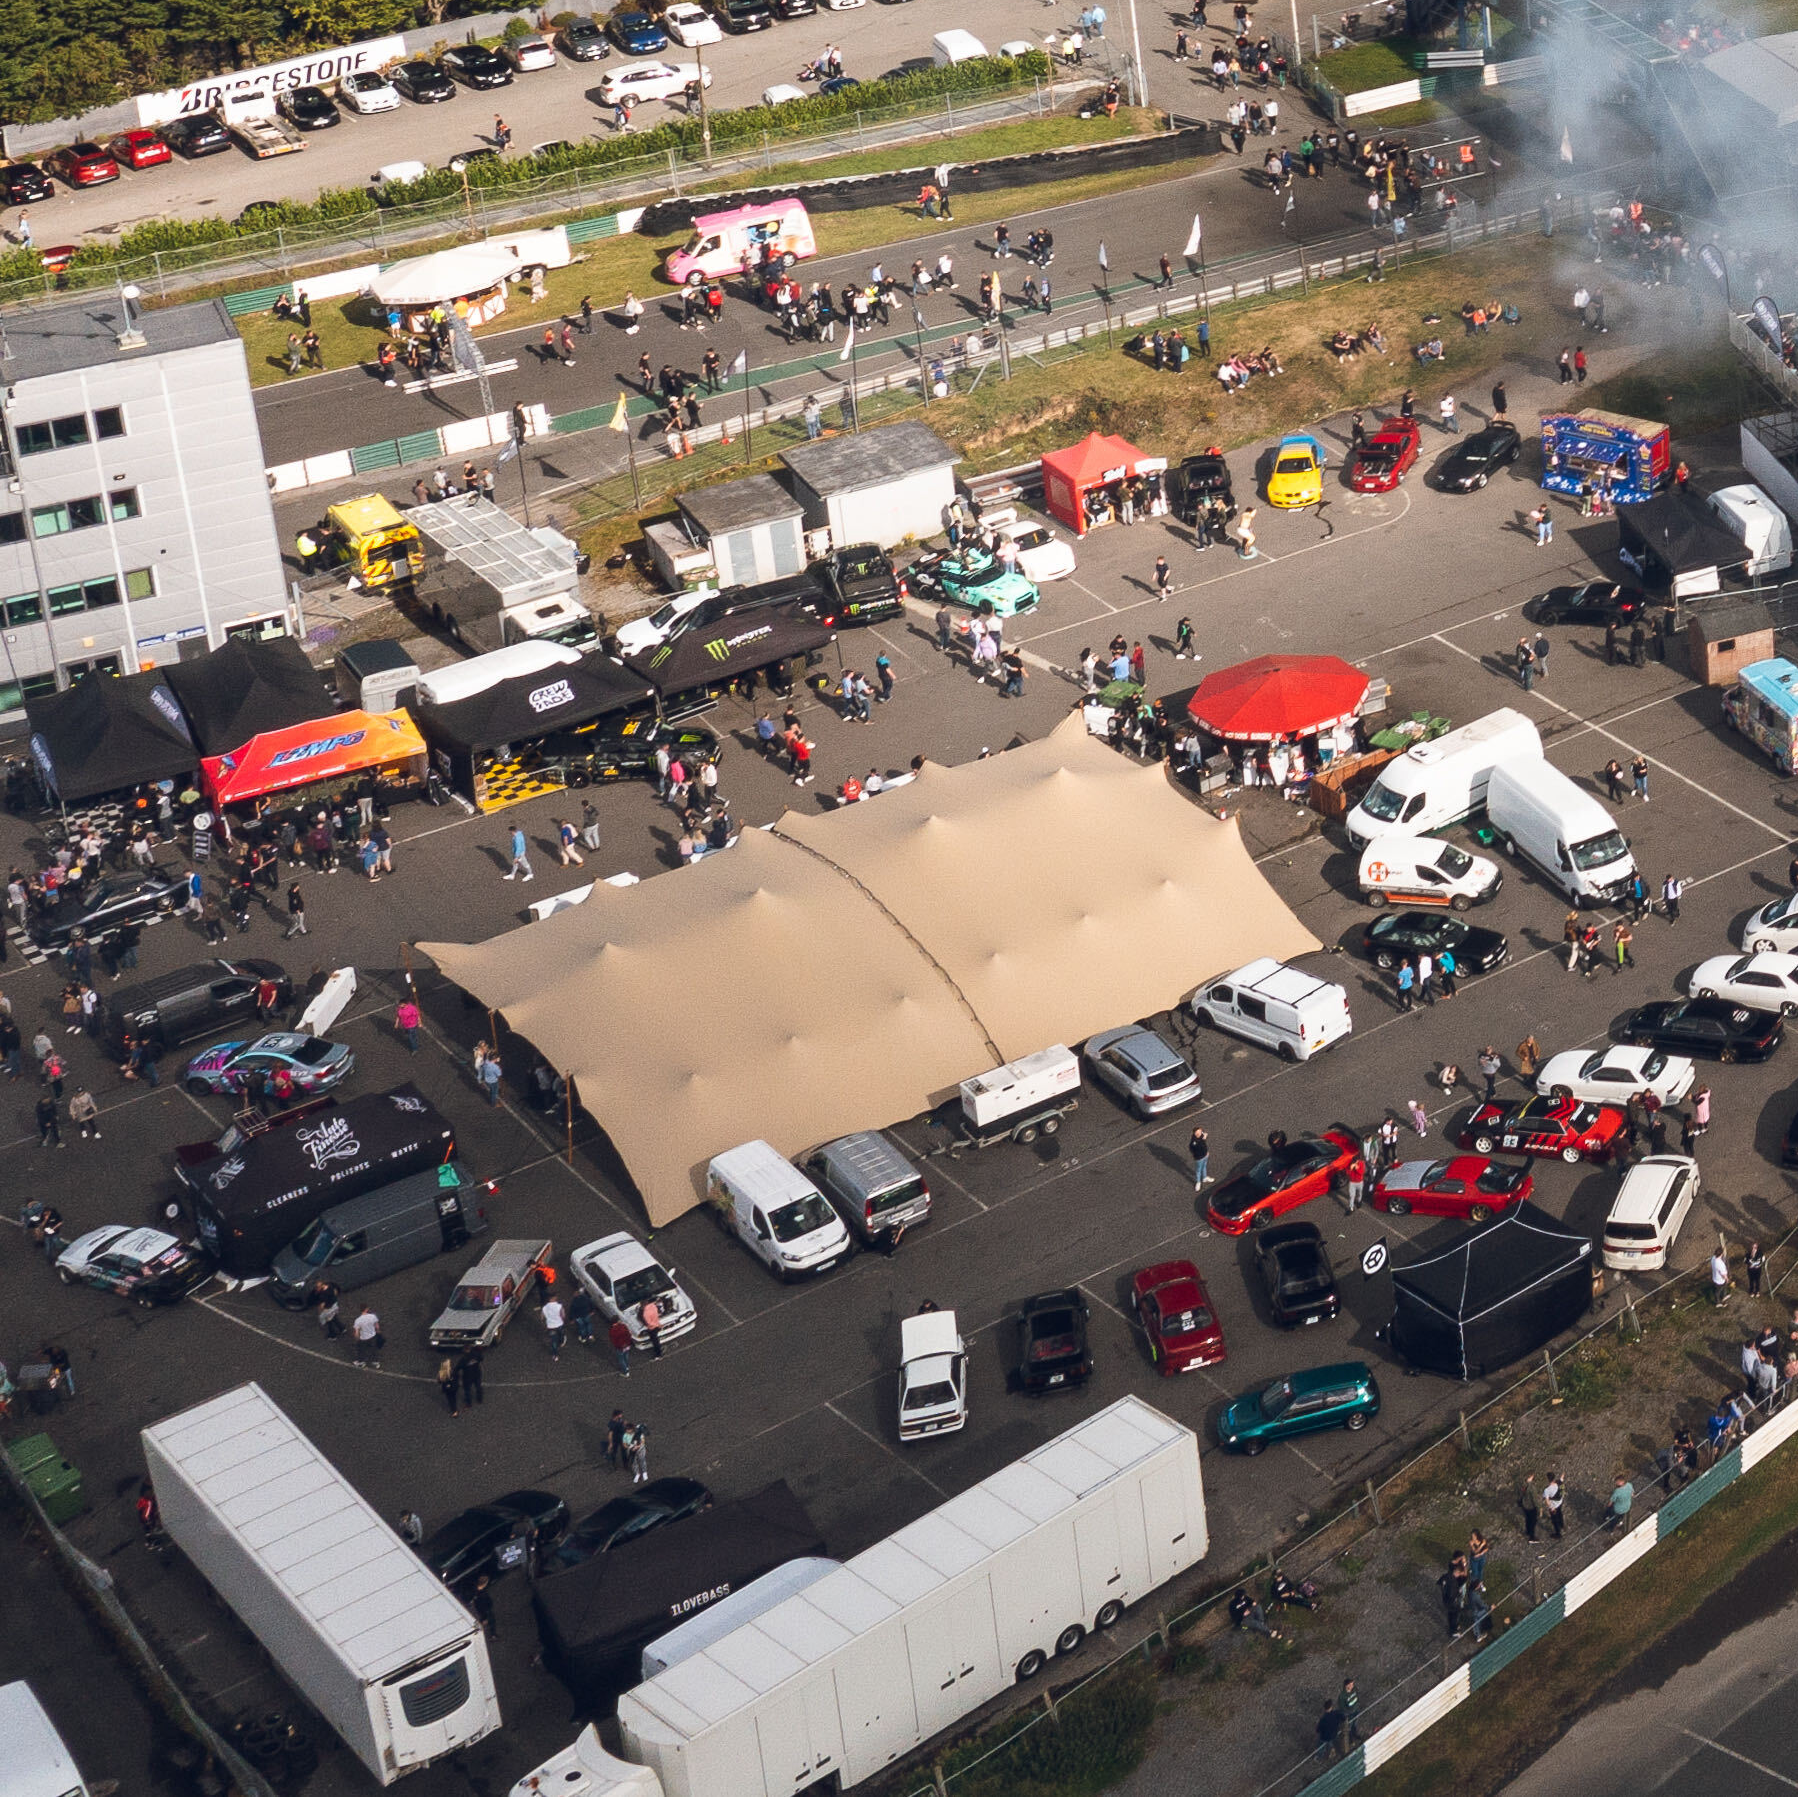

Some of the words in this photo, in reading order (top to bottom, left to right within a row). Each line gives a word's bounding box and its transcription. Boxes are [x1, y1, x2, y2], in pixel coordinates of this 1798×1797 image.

[180, 51, 367, 114] BRESTONE
[532, 683, 565, 702] CREW
[671, 1583, 729, 1617] ILOVEBASS
